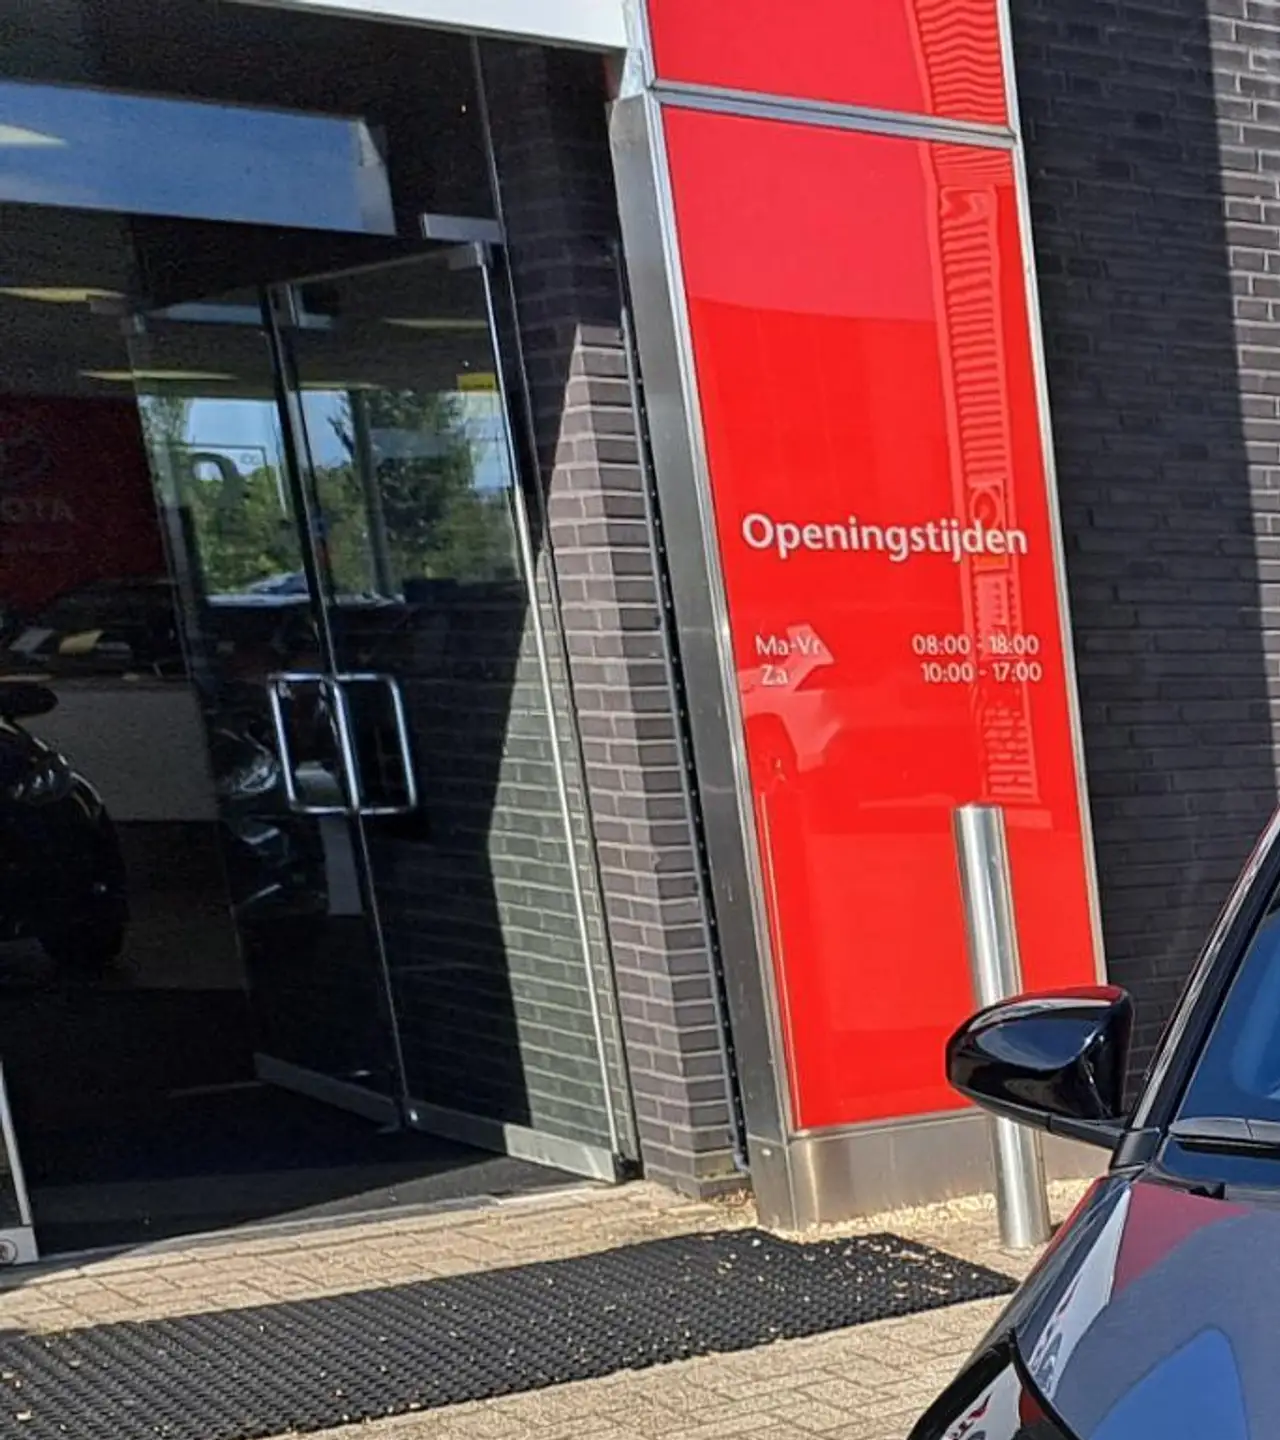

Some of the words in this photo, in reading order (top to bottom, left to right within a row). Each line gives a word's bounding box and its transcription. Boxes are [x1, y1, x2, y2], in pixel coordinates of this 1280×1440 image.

[742, 513, 1028, 563] Openingstijden
[755, 634, 822, 656] Ma-Vr
[911, 634, 971, 656] 08:00
[989, 634, 1039, 656] 18:00
[761, 664, 788, 686] Za
[921, 662, 974, 683] 10:00
[993, 662, 1042, 683] 17:00
